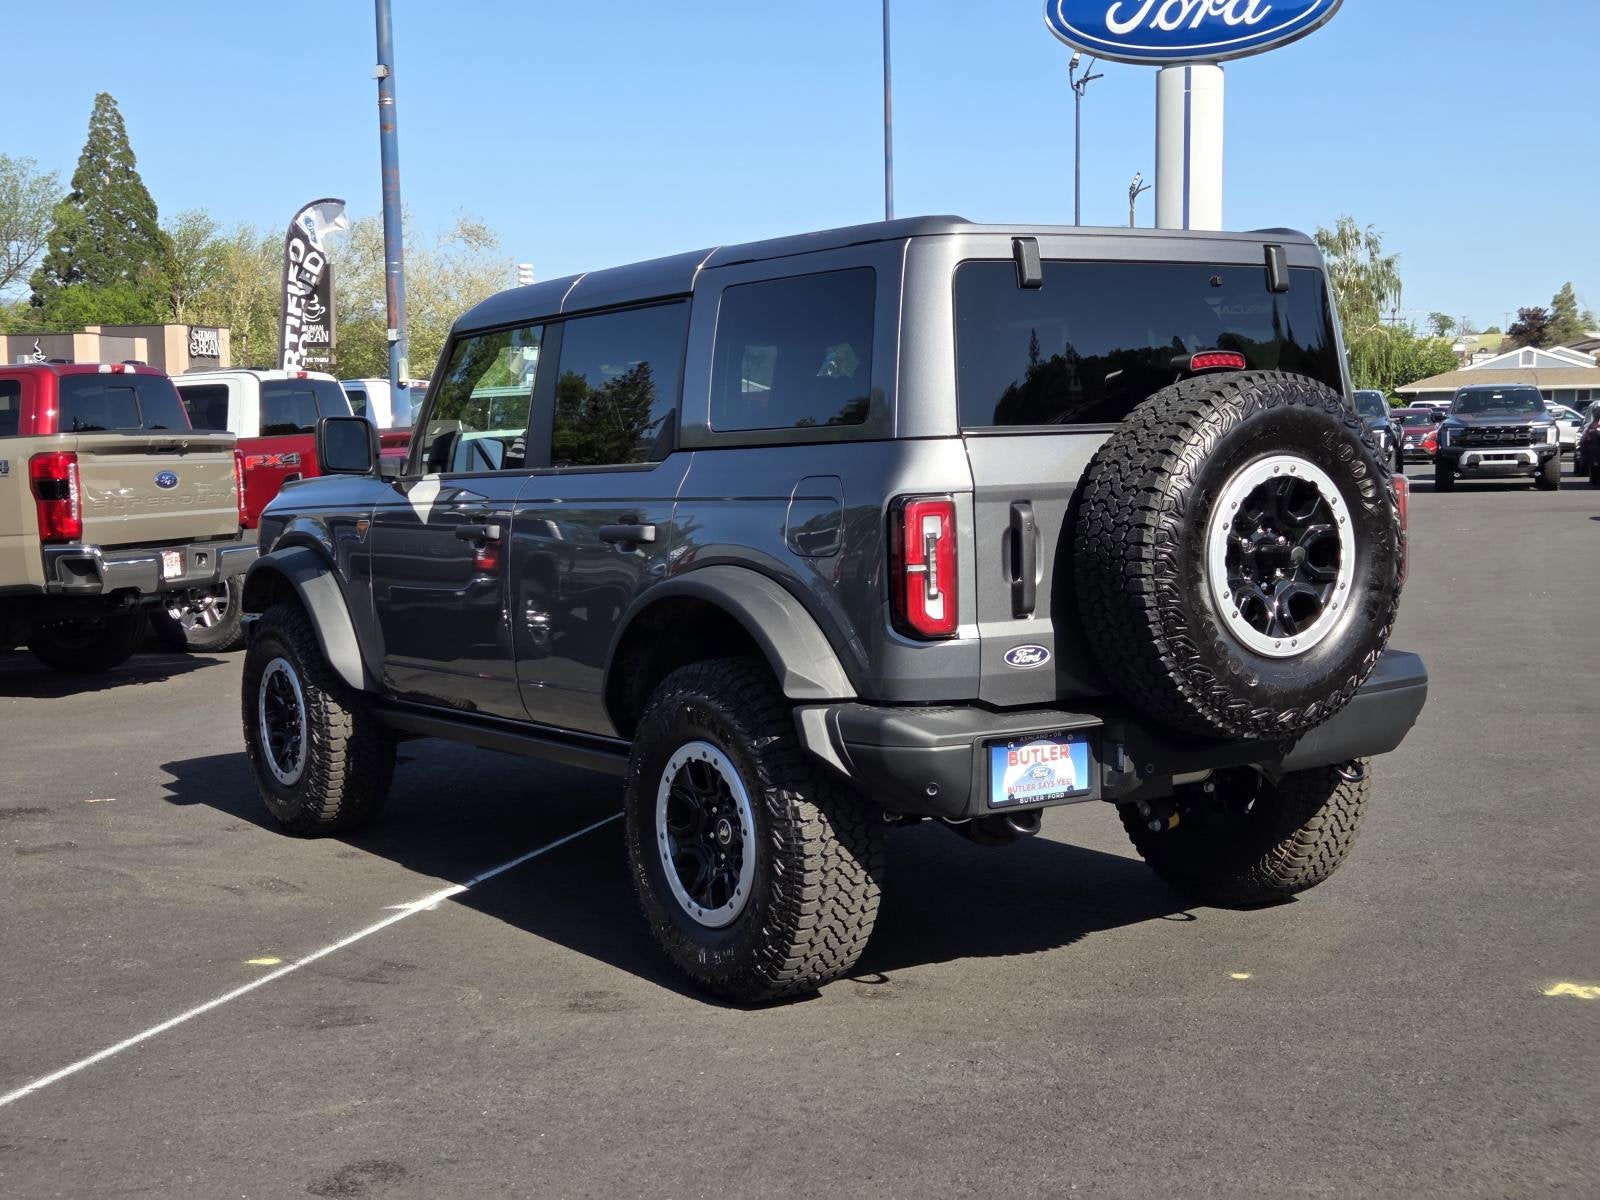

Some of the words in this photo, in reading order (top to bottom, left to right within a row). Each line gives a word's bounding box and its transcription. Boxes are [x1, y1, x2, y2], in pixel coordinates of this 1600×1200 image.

[245, 453, 300, 470] FX4
[1013, 648, 1042, 663] Ford
[1008, 745, 1070, 766] BUTLER
[1007, 783, 1037, 795] BUTLER
[1019, 795, 1045, 804] BUTLER
[1047, 792, 1066, 800] FORD
